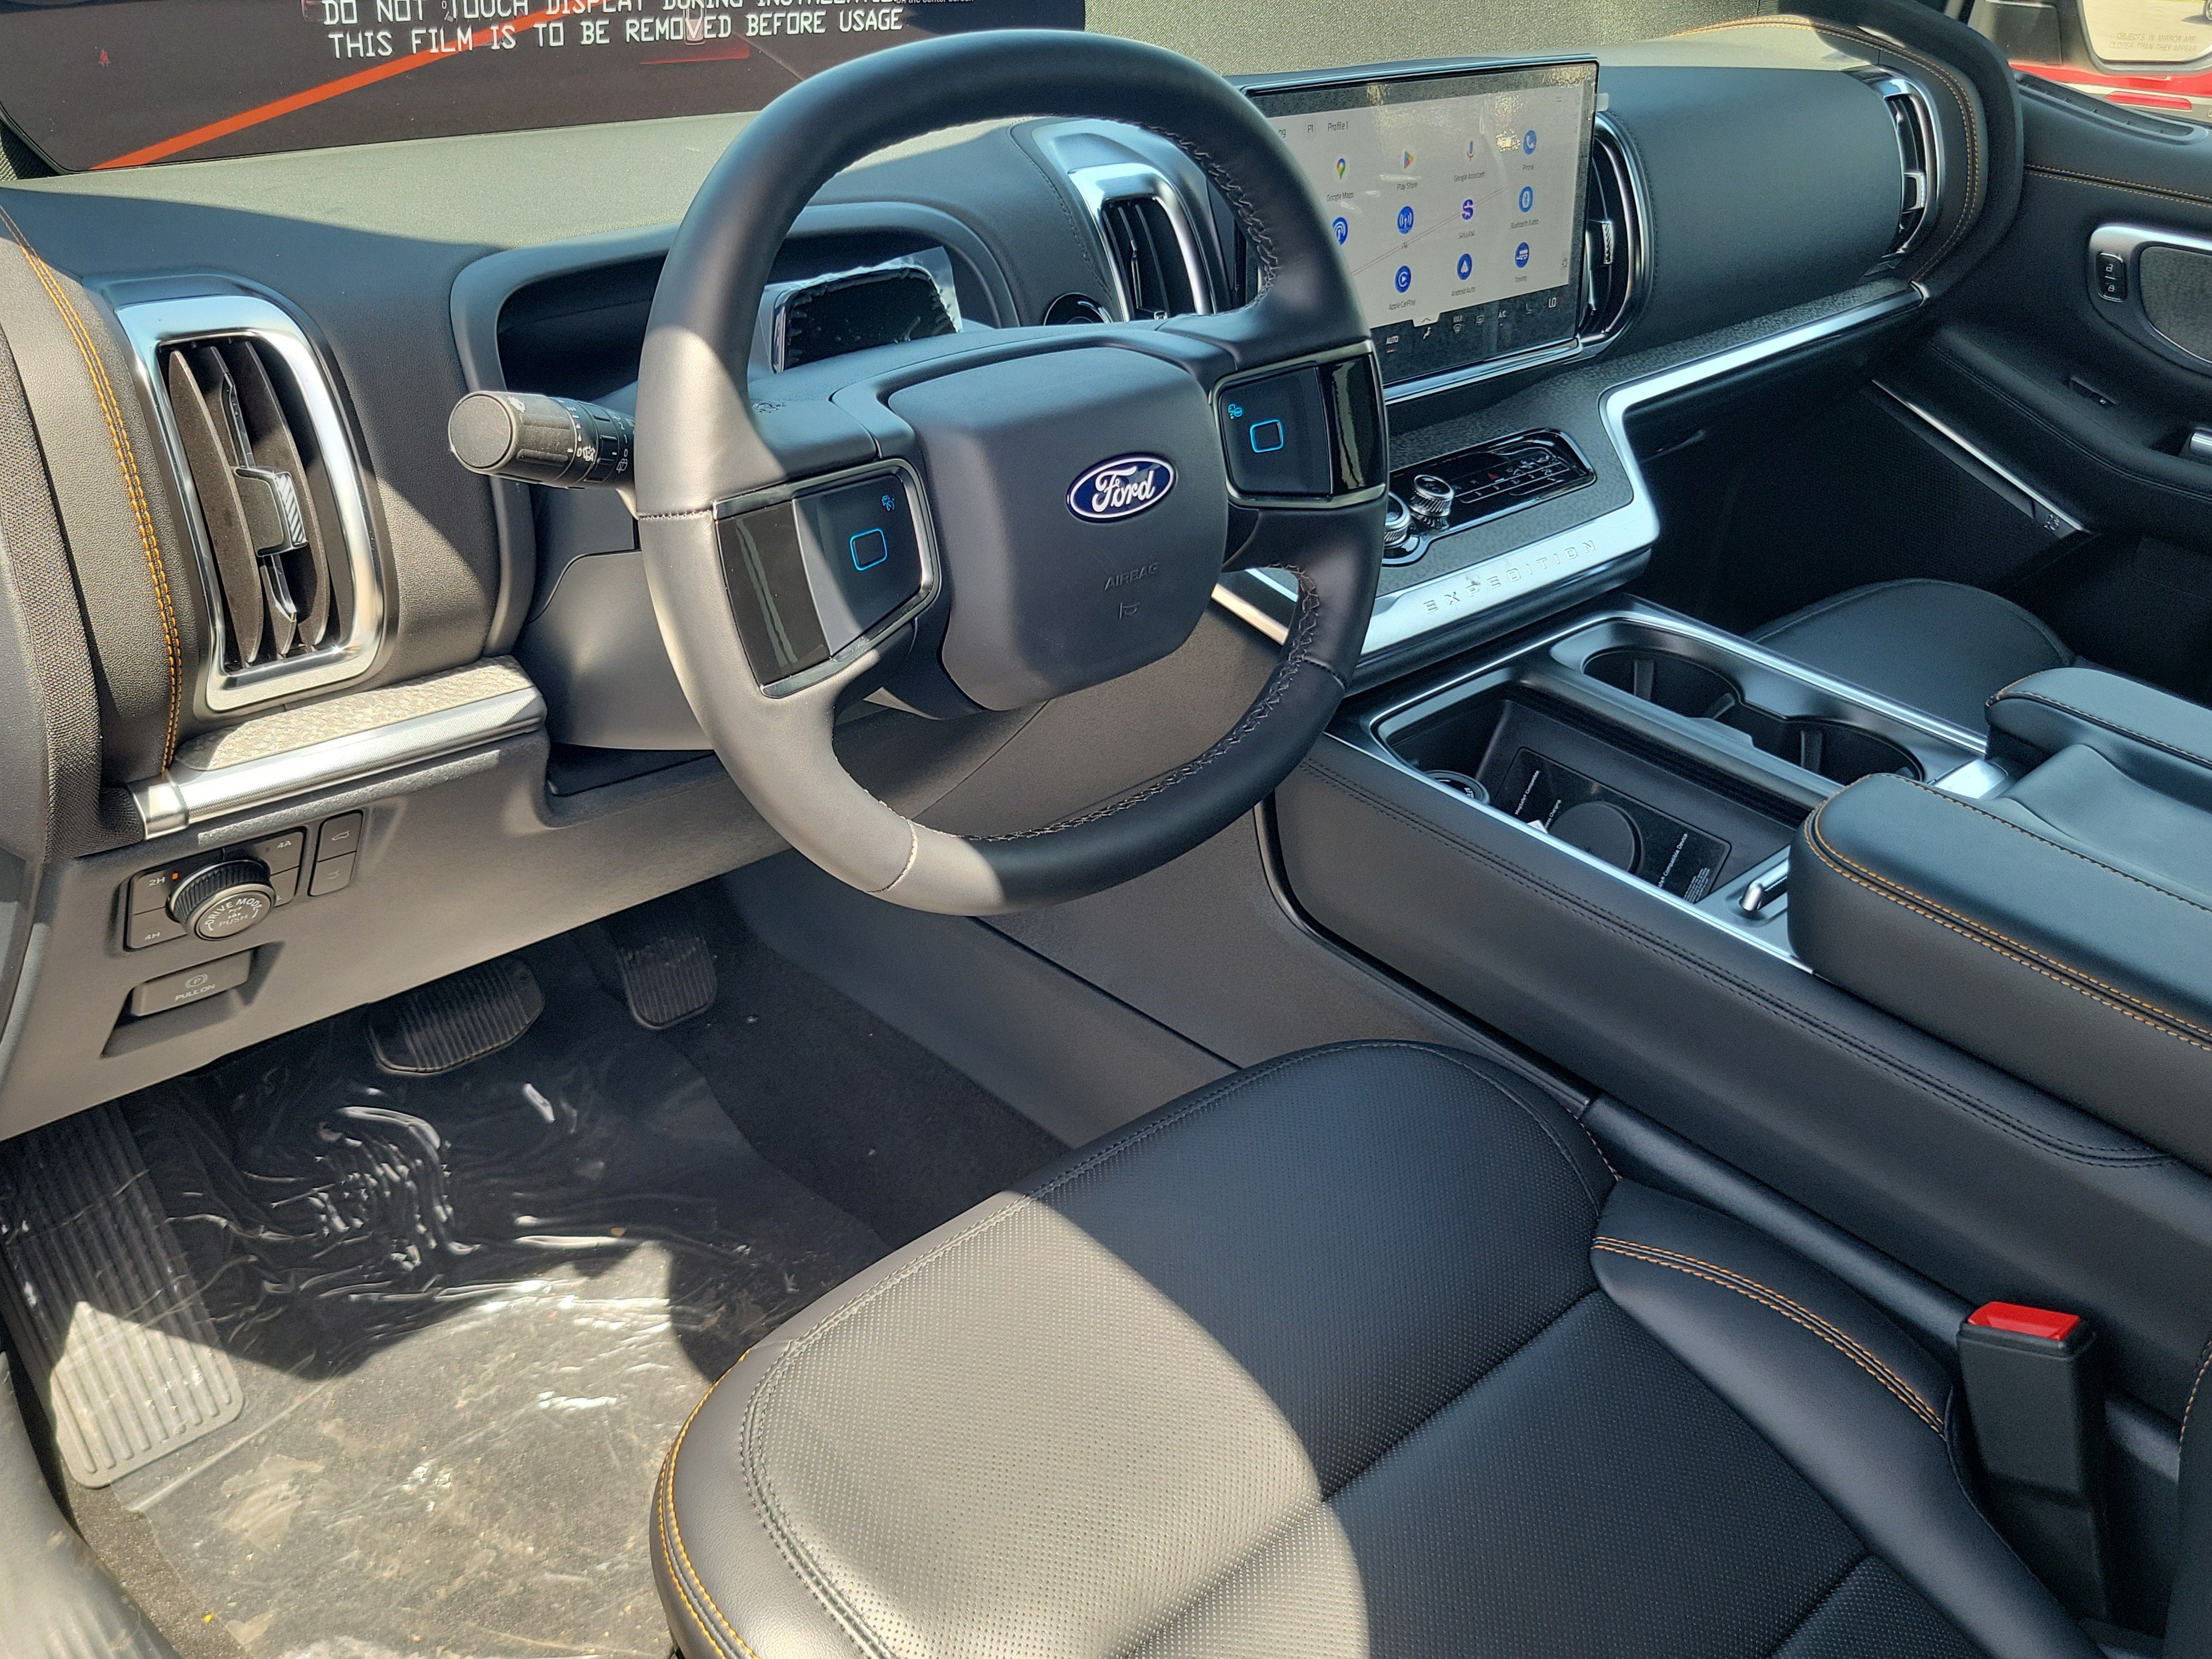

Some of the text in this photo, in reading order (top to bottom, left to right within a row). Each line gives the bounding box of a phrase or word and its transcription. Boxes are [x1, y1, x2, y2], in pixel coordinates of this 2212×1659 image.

[321, 0, 358, 25] DO
[377, 0, 427, 22] NOT
[452, 0, 528, 19] TOUCH
[328, 7, 903, 59] THIS FILM IS TO BE REMOVED BEFORE USAGE
[2117, 32, 2146, 41] OBJECTS
[1397, 183, 1406, 191] Play
[1327, 194, 1342, 202] Google
[1548, 297, 1557, 308] LO
[1386, 335, 1399, 345] AUTO
[1092, 466, 1156, 512] Ford
[1104, 563, 1160, 592] AIRBAG
[1423, 540, 1596, 614] EXPEDITION
[149, 876, 166, 886] 2H
[205, 898, 262, 926] DRIVE MODE
[219, 914, 249, 927] PUSH
[144, 932, 160, 940] 4H
[176, 984, 216, 1002] PULL ON
